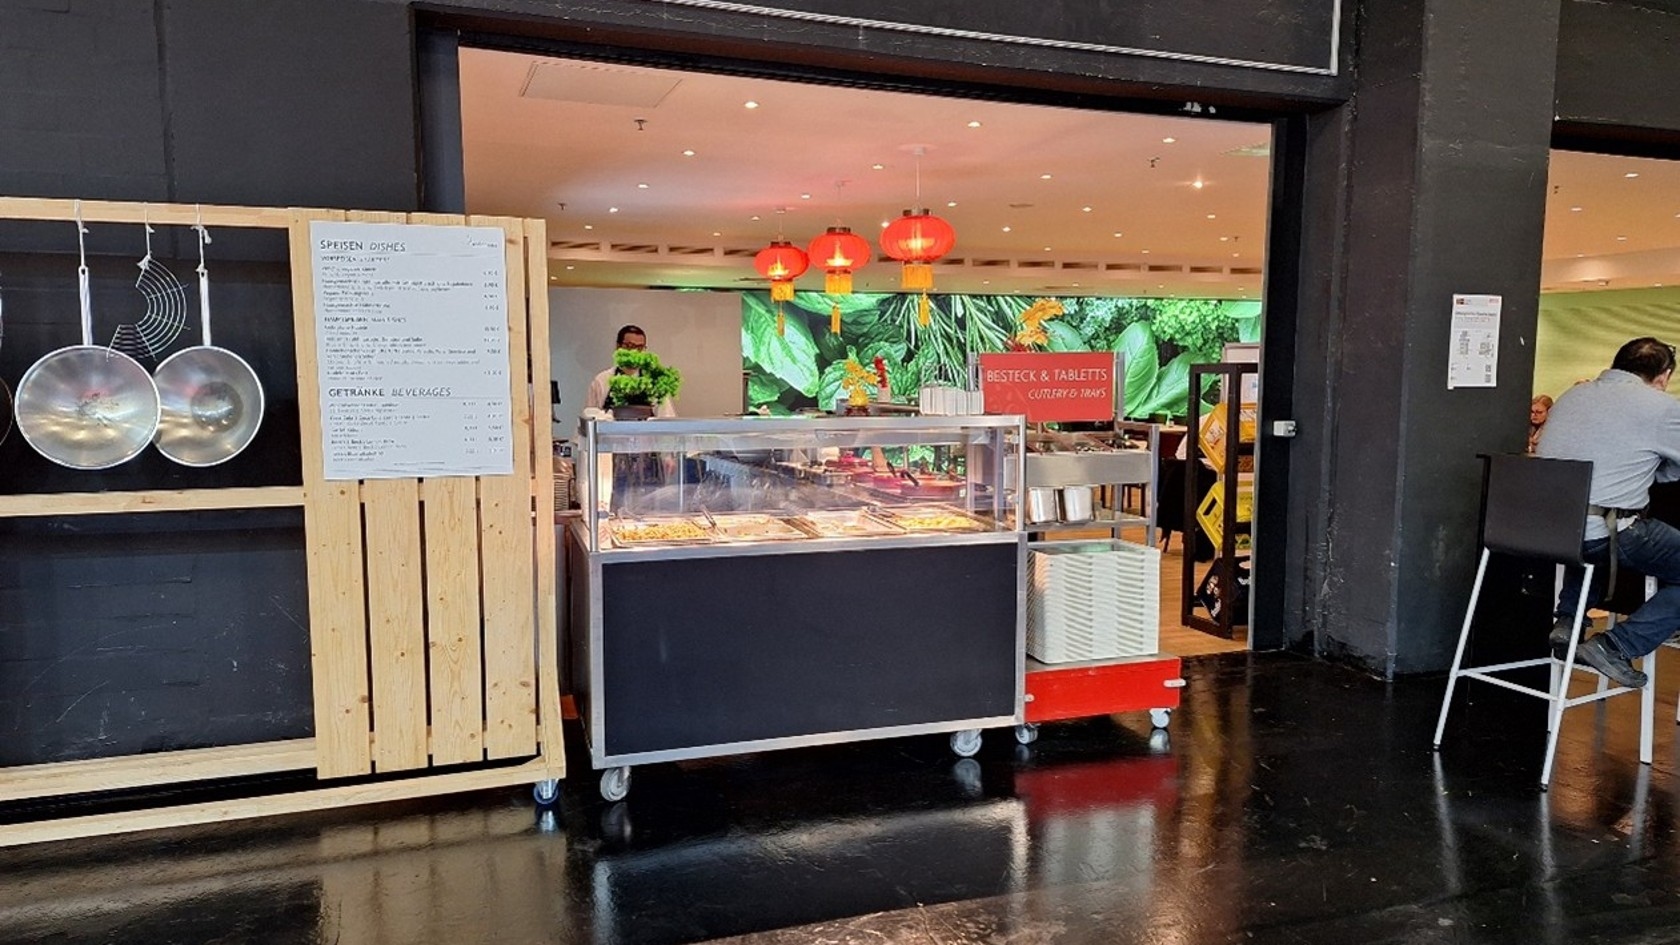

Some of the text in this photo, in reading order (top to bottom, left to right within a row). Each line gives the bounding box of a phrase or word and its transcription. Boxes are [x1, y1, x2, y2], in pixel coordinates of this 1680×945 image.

[320, 239, 406, 252] SPEISEN DISHES
[986, 368, 1107, 382] BESTECK & TABLETTS
[328, 386, 452, 397] GETRÄNKE BEVERAGES
[1028, 388, 1069, 400] CUTLERY
[1080, 387, 1107, 398] TRAYS
